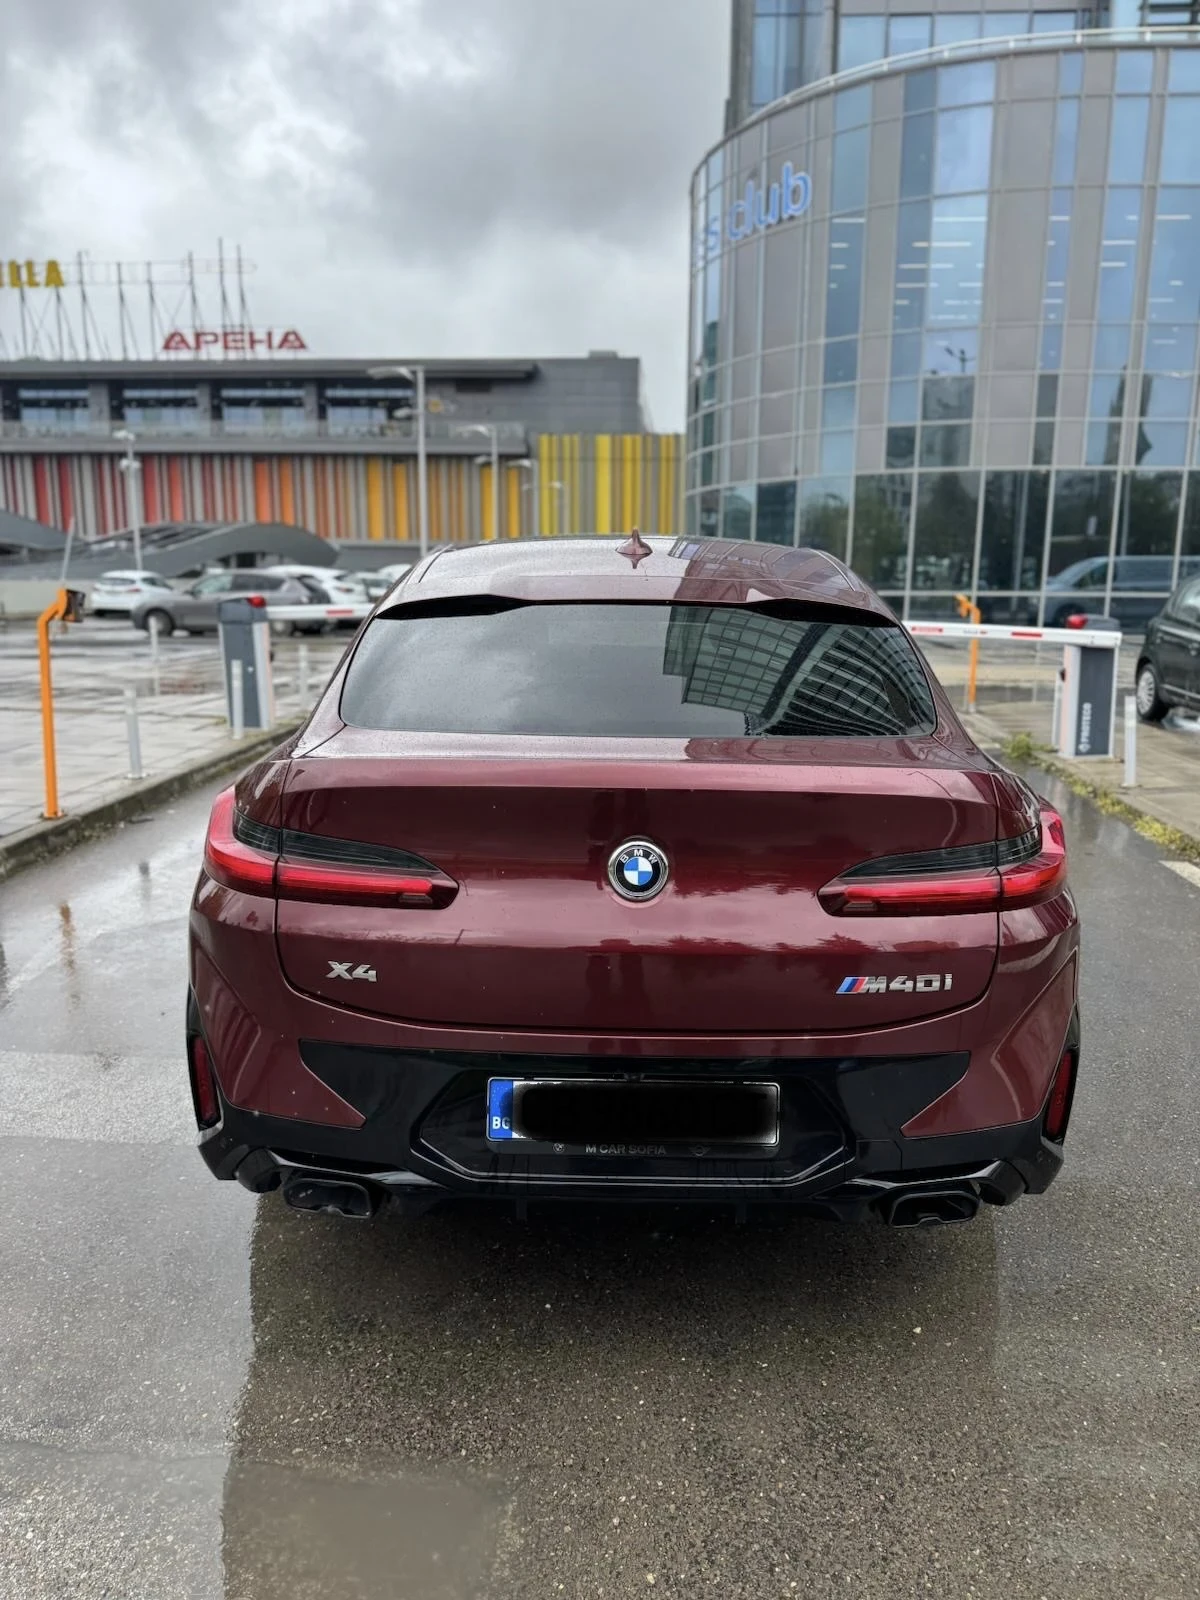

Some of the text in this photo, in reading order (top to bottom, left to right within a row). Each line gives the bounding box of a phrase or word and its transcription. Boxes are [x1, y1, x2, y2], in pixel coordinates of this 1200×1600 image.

[162, 329, 307, 350] АРЕНА
[620, 849, 658, 864] BMW
[326, 961, 377, 982] X4
[857, 974, 953, 993] M40i
[492, 1116, 511, 1130] BG
[586, 1145, 667, 1156] M CAR SOFIA
